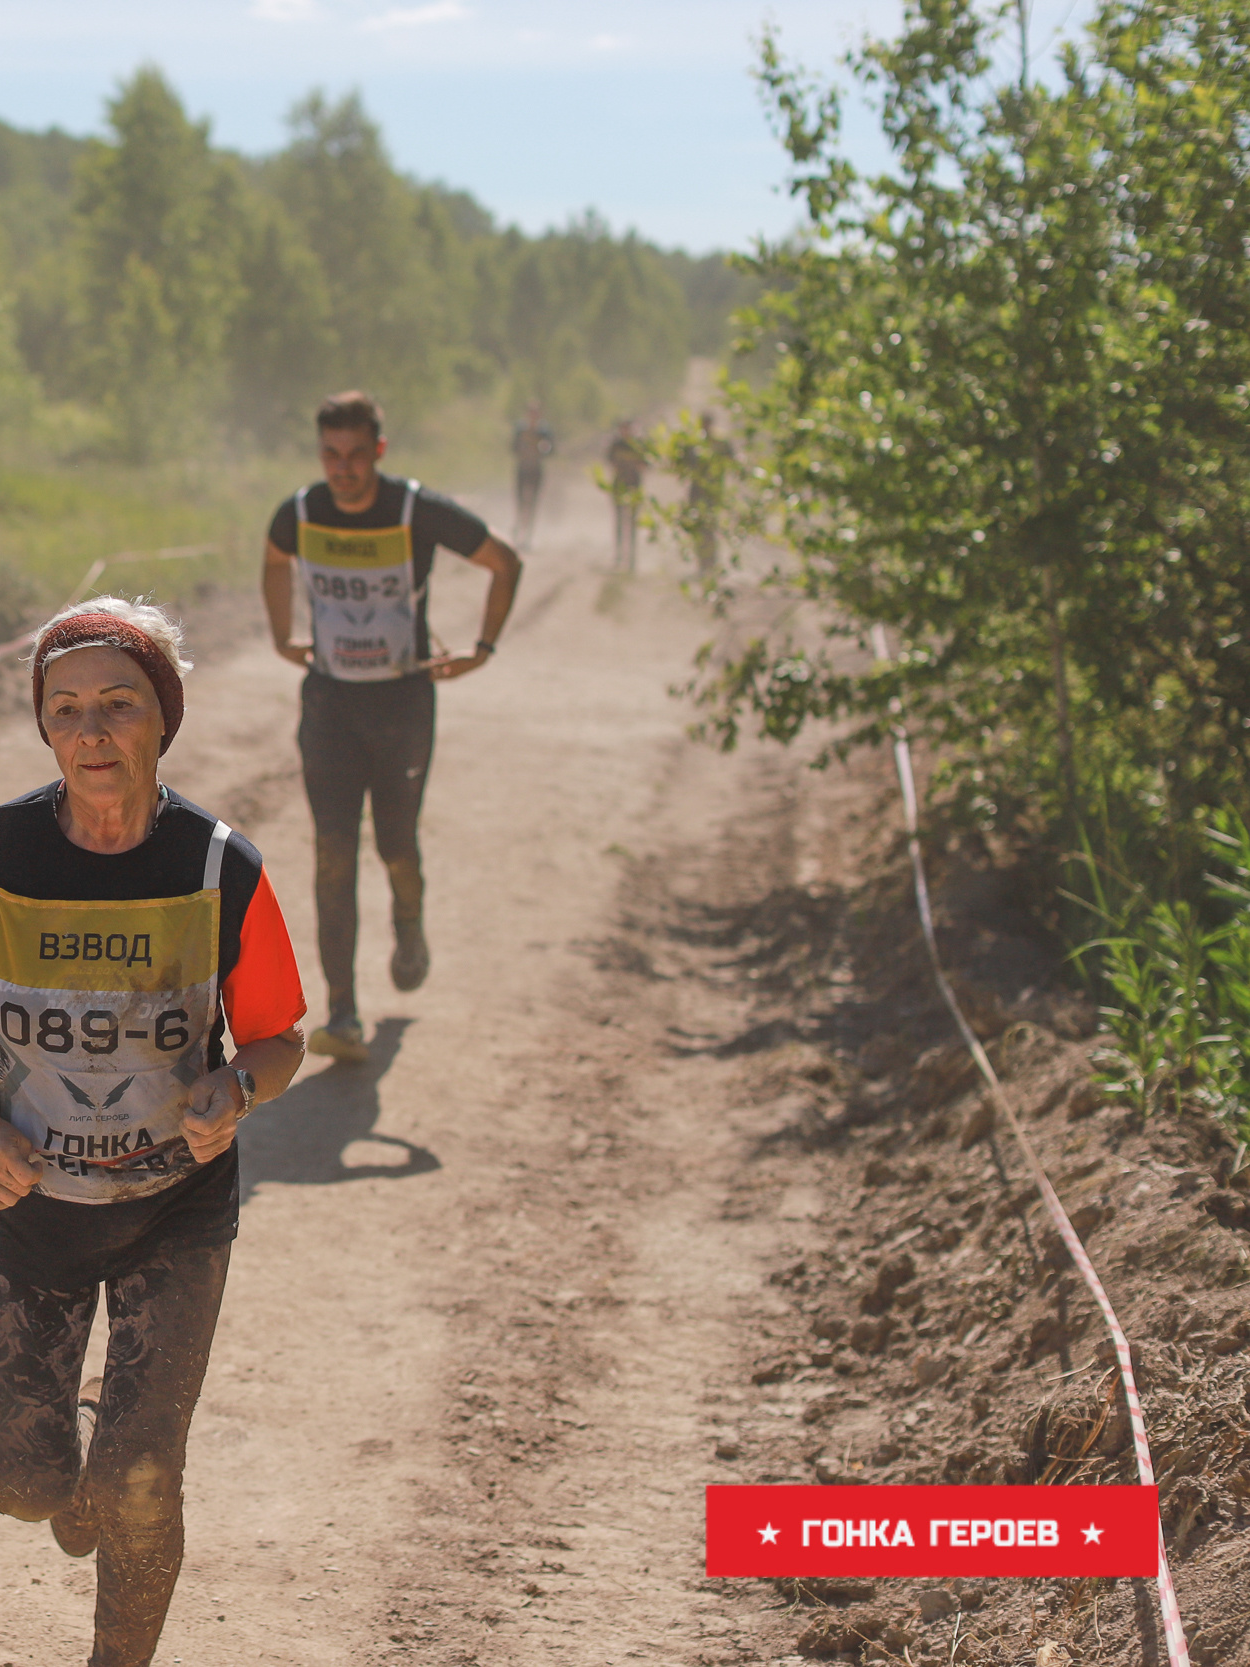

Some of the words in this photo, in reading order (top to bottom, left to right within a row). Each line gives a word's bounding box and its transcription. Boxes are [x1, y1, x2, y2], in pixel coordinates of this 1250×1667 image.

[313, 573, 400, 602] 089-2
[39, 932, 152, 967] ВЗВОД
[0, 1001, 189, 1054] 089-6
[95, 1113, 130, 1122] ГЕРОЕВ
[43, 1126, 154, 1157] ГОНКА
